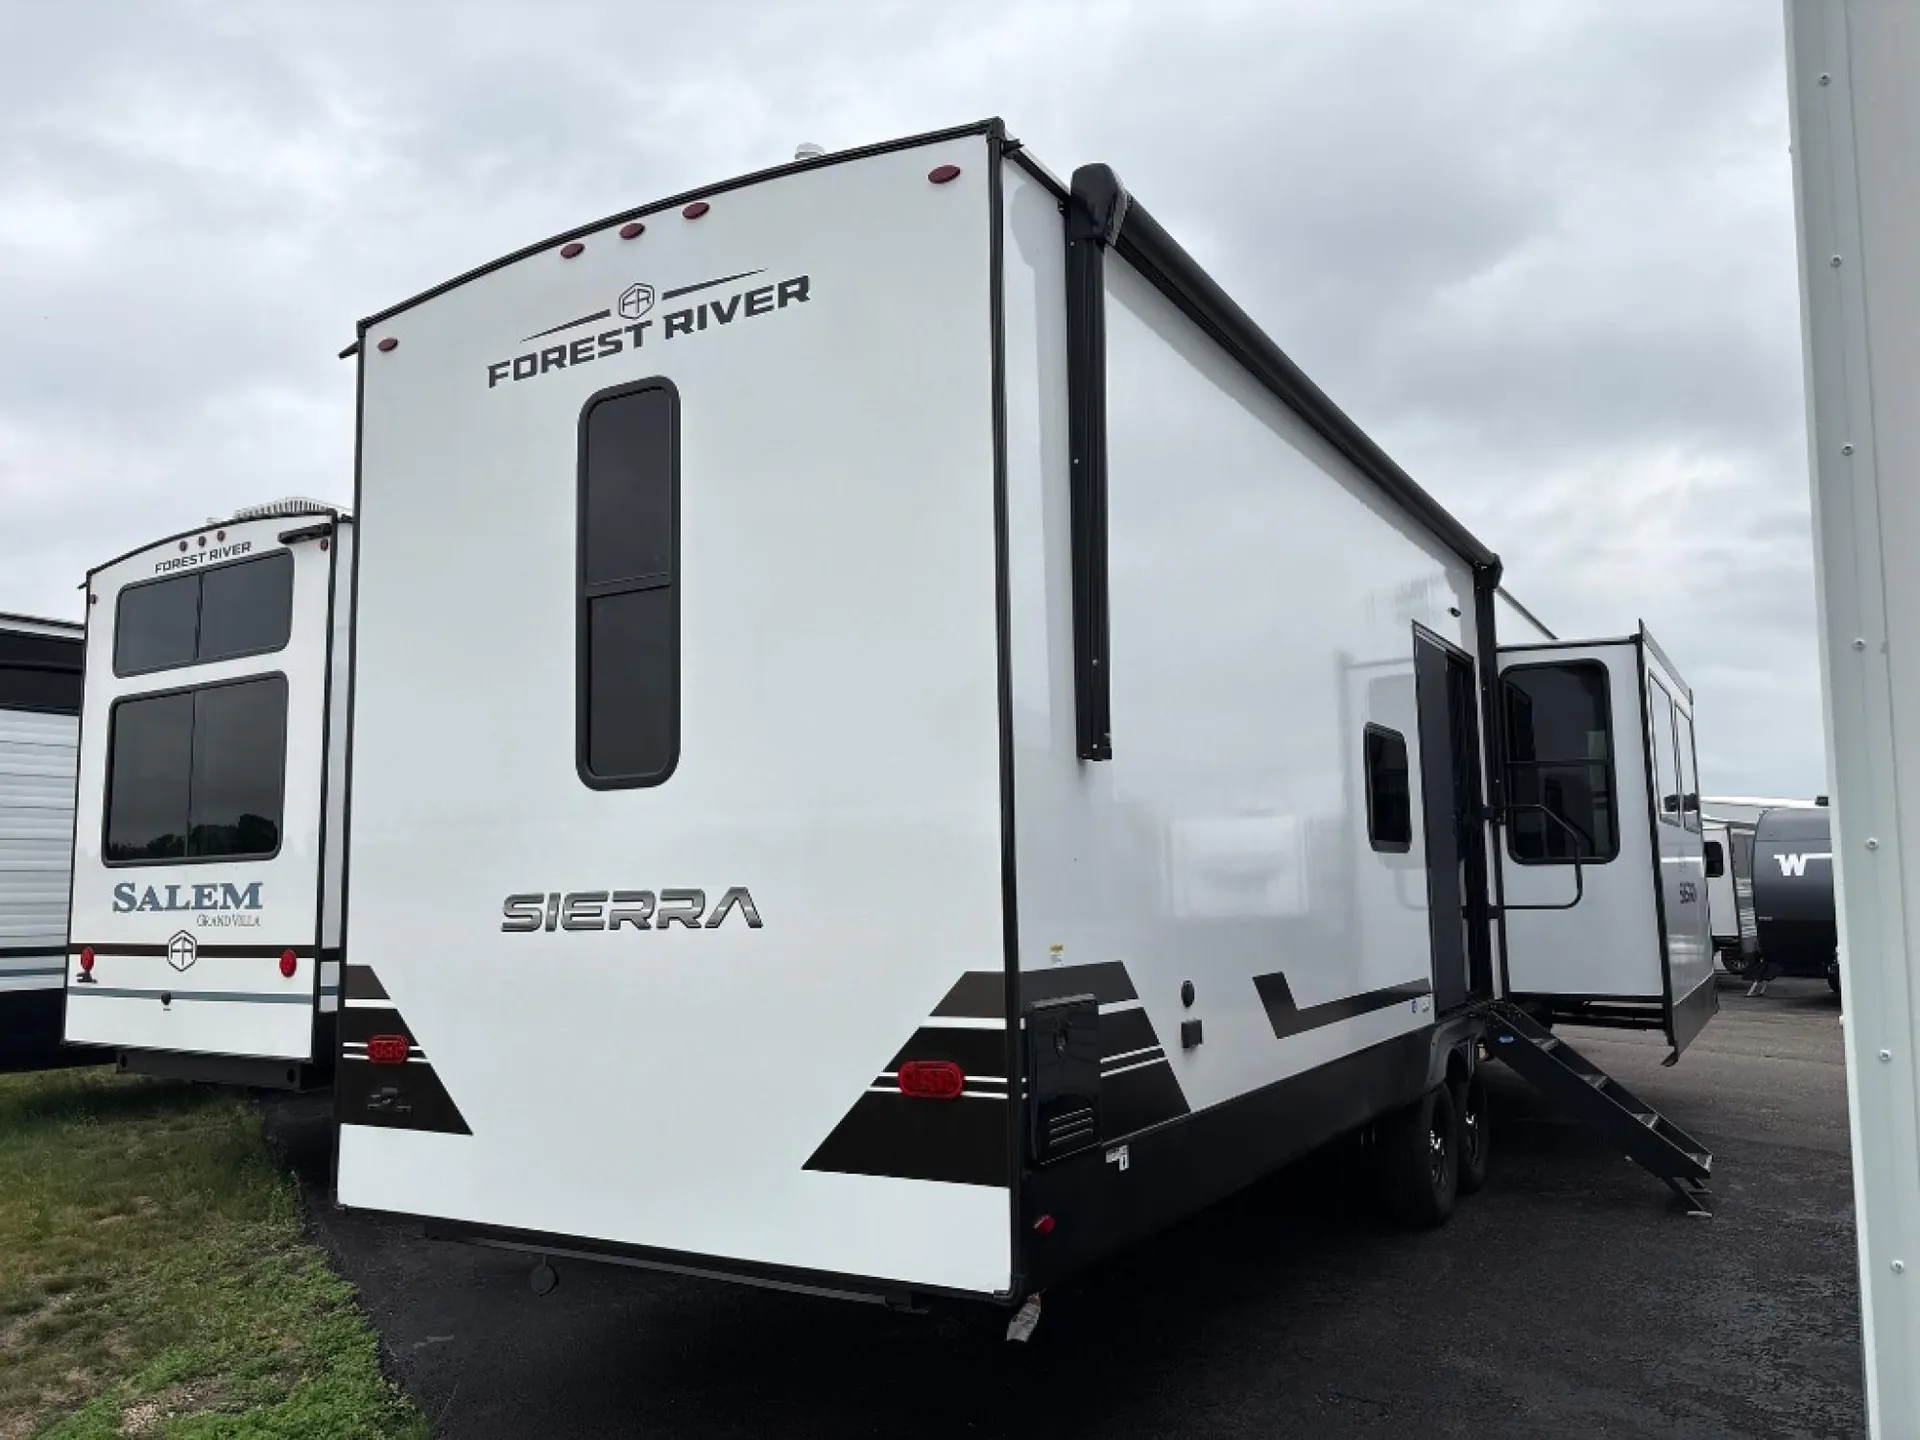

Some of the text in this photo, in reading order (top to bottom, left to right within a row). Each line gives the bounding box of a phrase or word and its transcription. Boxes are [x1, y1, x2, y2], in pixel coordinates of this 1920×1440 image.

[487, 275, 811, 389] FOREST RIVER
[155, 541, 252, 573] FOREST RIVER
[112, 882, 263, 913] SALEM
[500, 886, 764, 932] SIERRA
